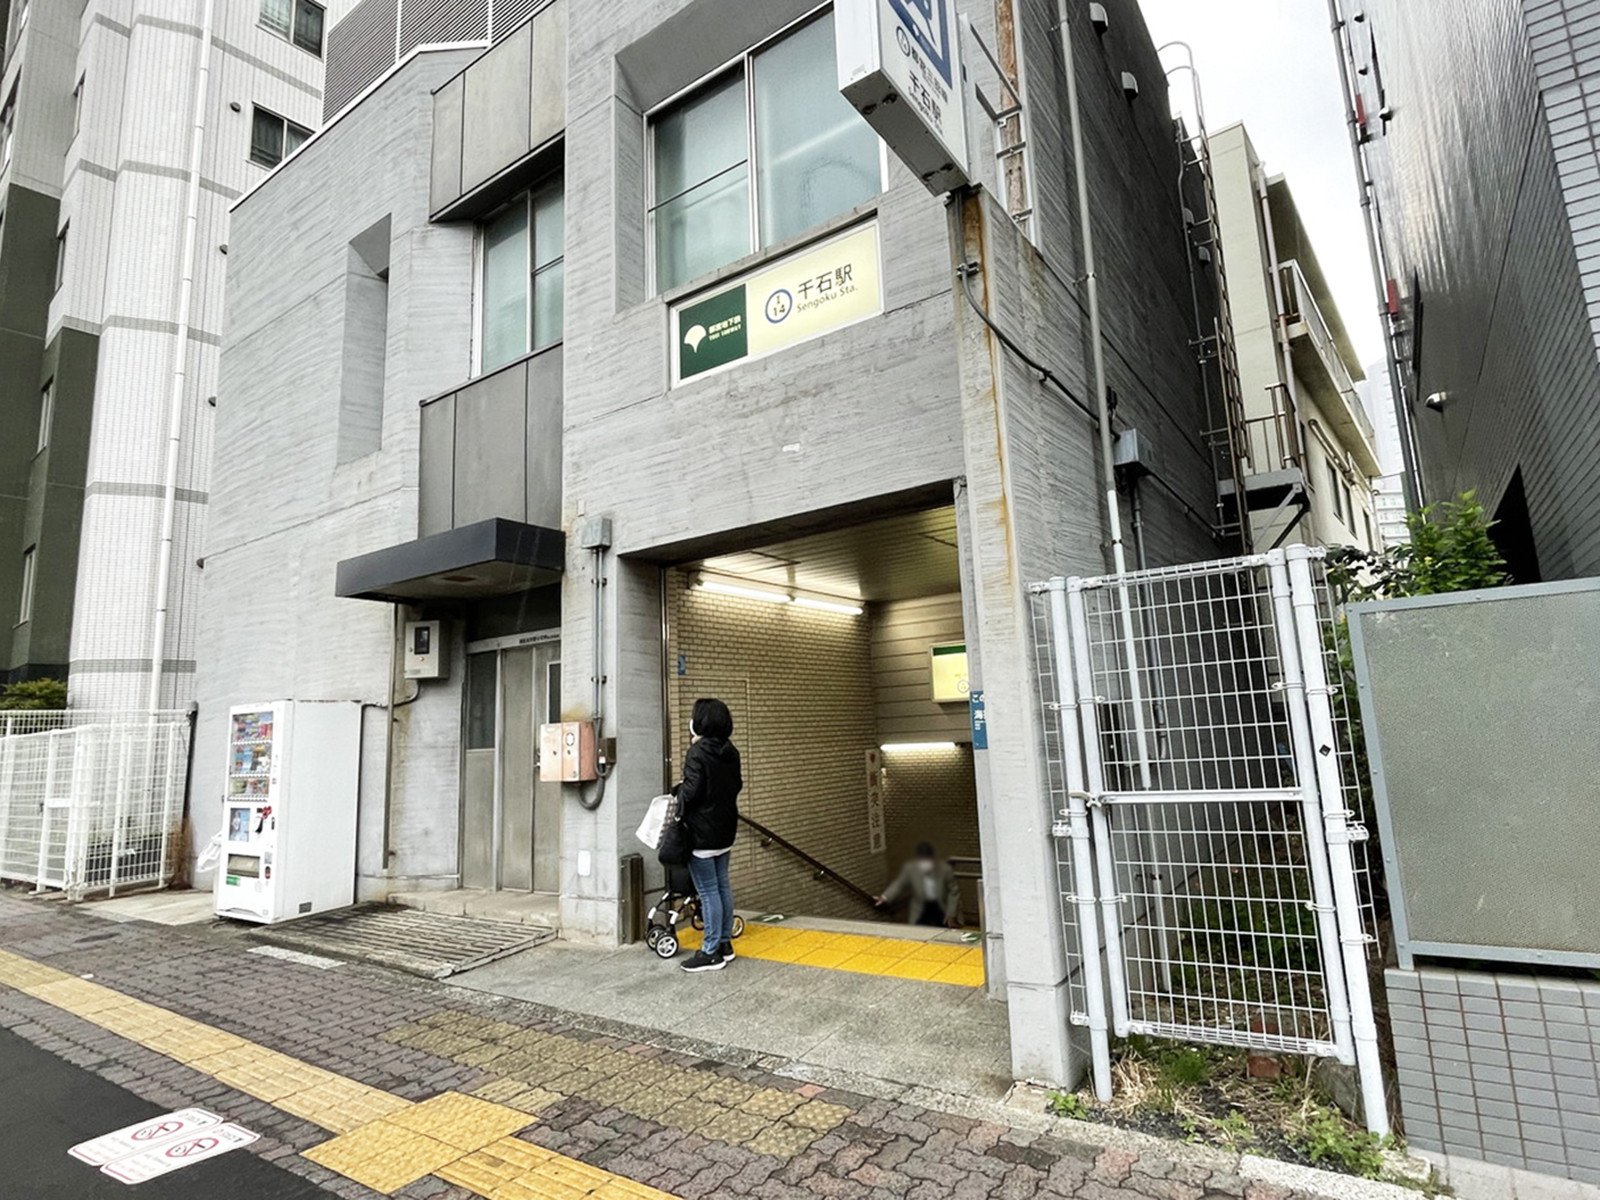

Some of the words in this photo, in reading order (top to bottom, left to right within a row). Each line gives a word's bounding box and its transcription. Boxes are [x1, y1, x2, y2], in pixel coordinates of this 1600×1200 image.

[797, 264, 852, 300] 千石駅
[773, 304, 786, 316] 14
[797, 292, 837, 313] Sengoku
[840, 284, 858, 297] Sta.
